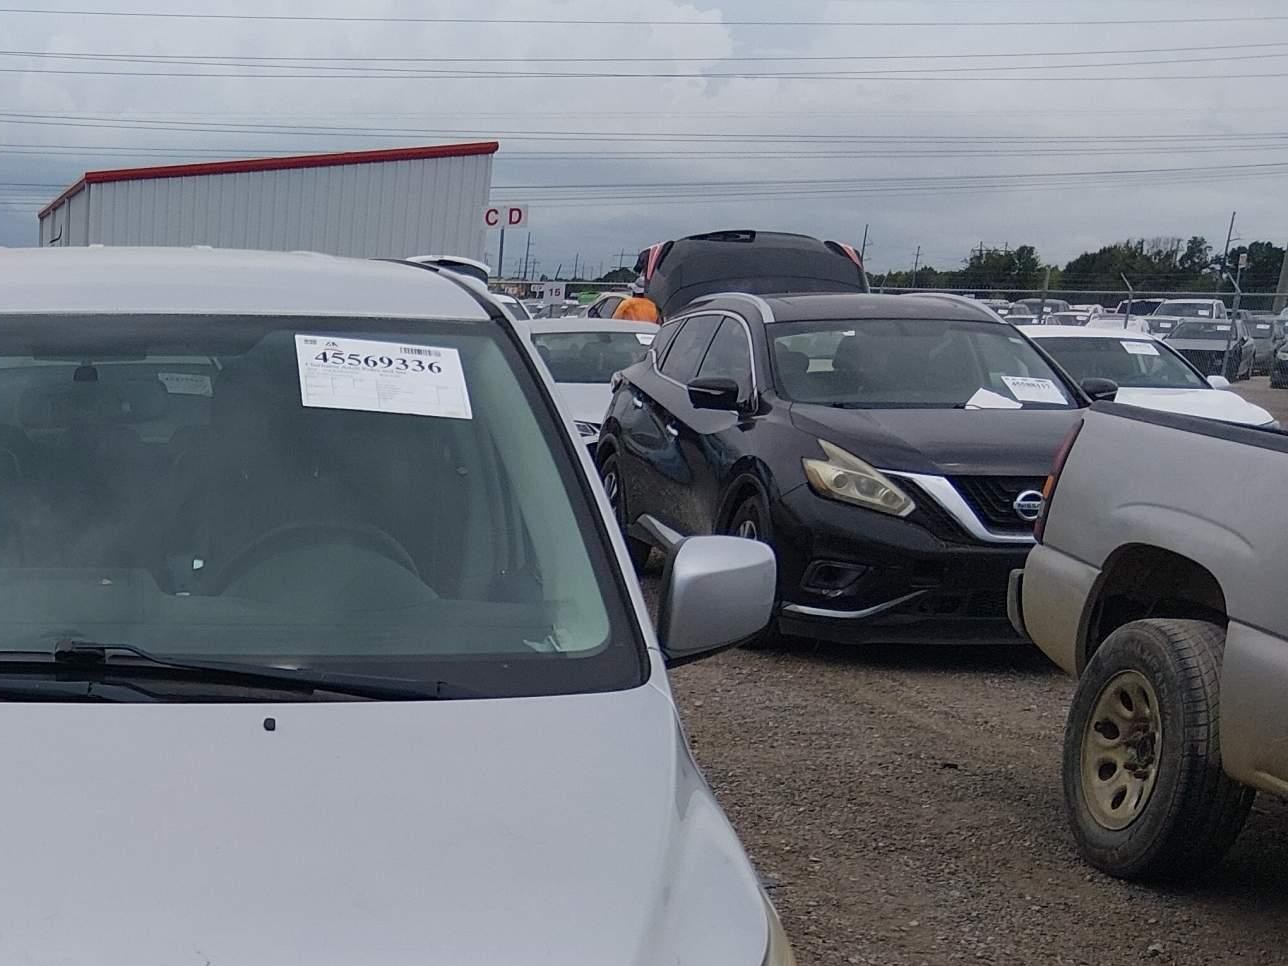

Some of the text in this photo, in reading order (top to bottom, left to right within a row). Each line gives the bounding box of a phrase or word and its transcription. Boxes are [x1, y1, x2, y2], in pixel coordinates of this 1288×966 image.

[485, 207, 522, 226] C D
[549, 288, 561, 297] 15
[314, 351, 443, 375] 45569336
